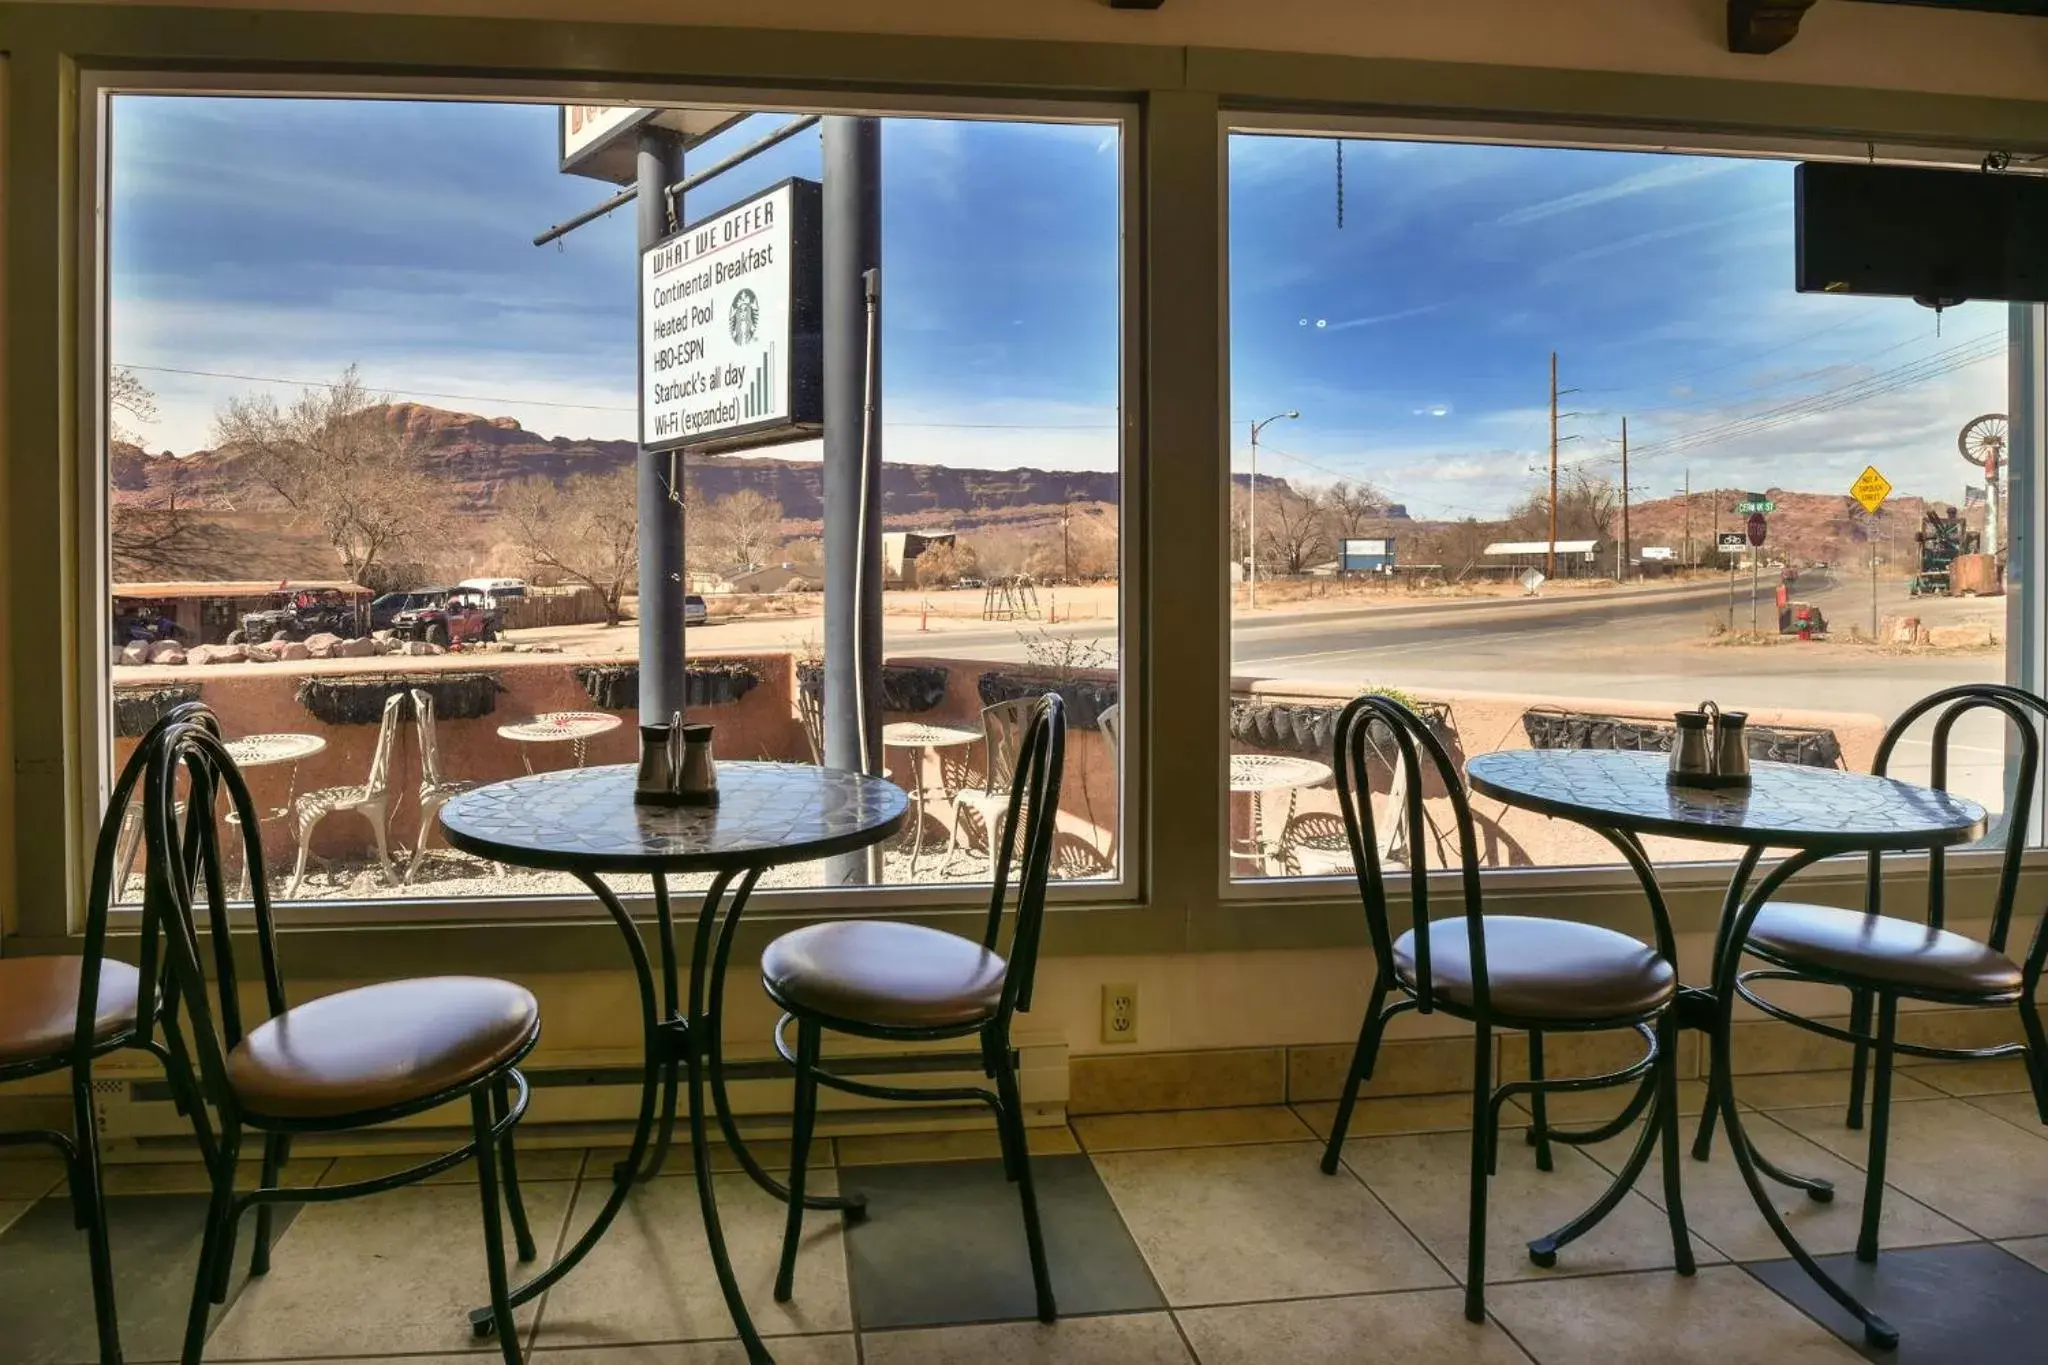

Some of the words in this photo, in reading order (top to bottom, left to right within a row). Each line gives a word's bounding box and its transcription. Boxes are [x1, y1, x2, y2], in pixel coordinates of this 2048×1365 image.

[653, 240, 690, 274] WHAT
[696, 226, 717, 255] WE
[724, 201, 774, 242] OFFER
[653, 265, 712, 309] Continental
[715, 243, 773, 284] Breakfast
[653, 308, 688, 340] Heated
[691, 298, 714, 328] Pool
[653, 336, 704, 373] HBO-ESPN
[654, 371, 706, 404] Starbuck's
[709, 365, 722, 390] all
[724, 363, 746, 389] day
[654, 411, 678, 436] Wi-Fi
[681, 396, 741, 434] (expanded)
